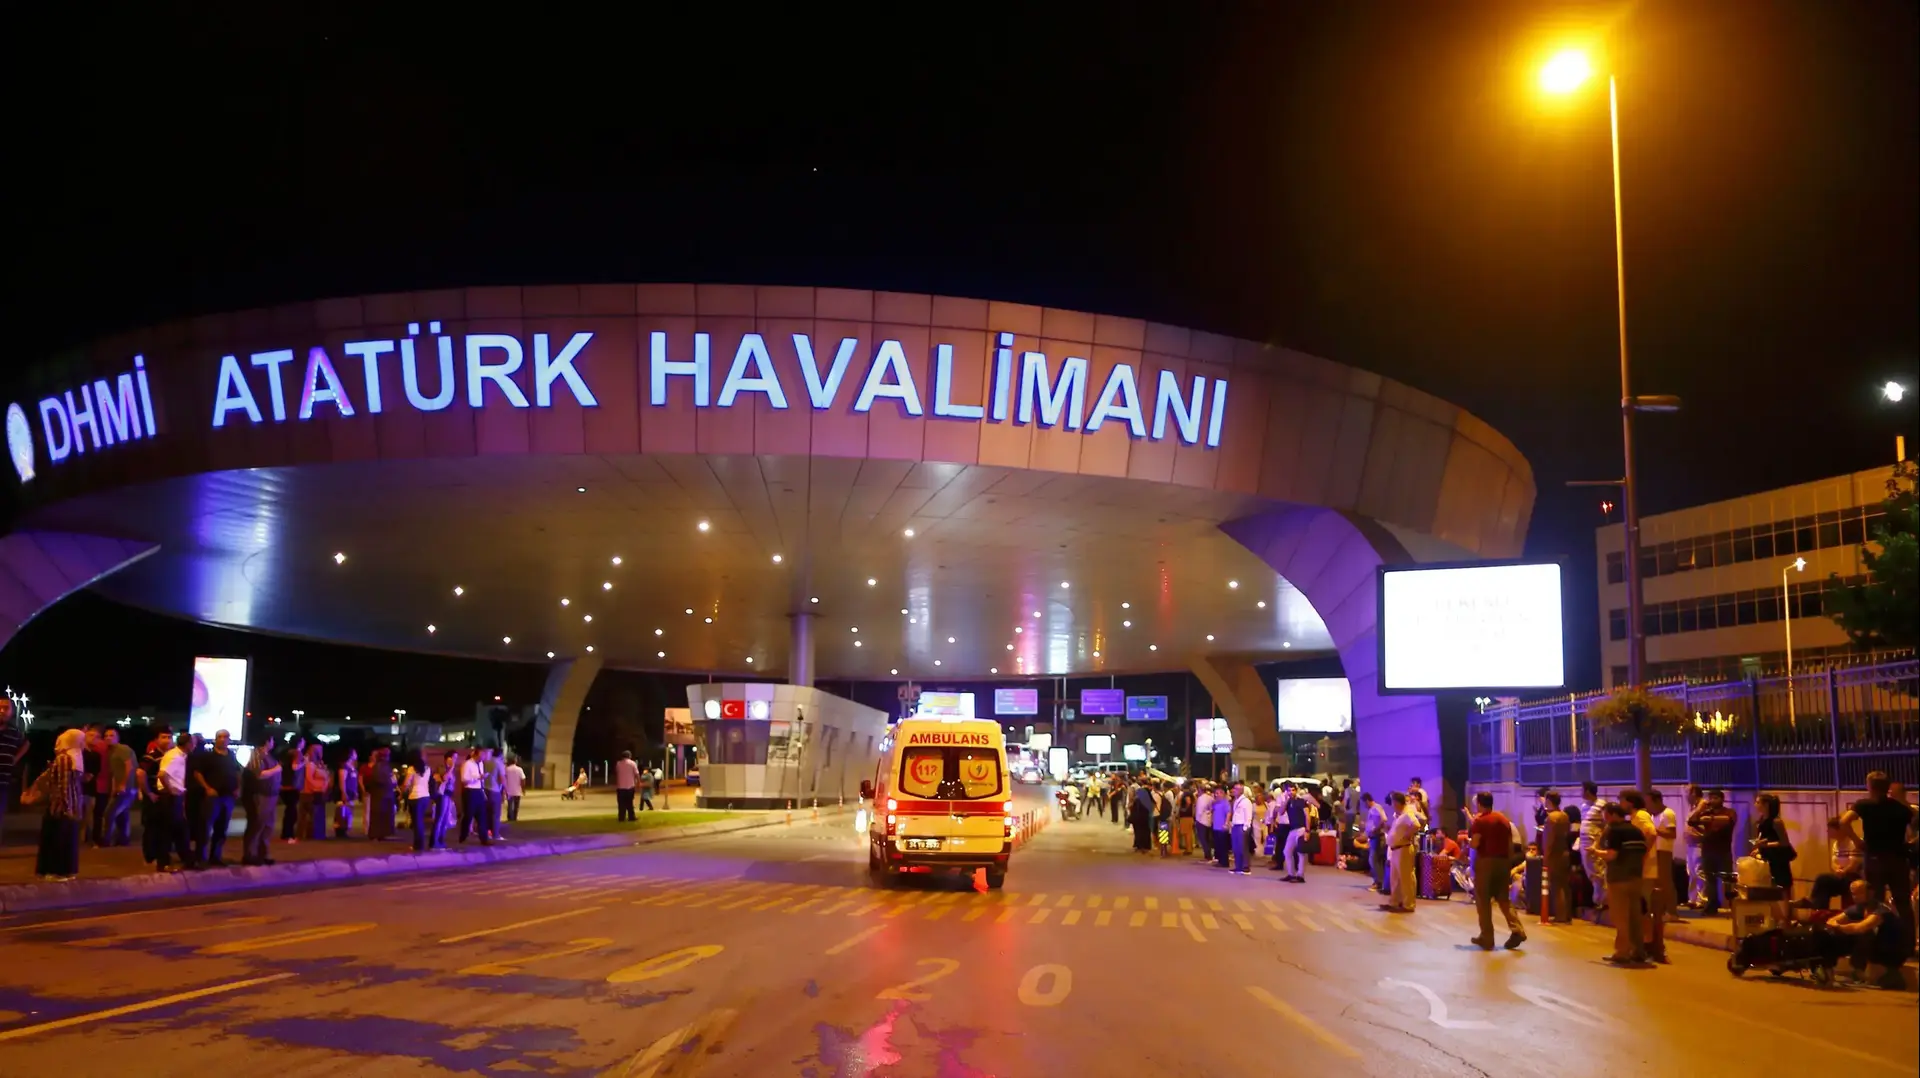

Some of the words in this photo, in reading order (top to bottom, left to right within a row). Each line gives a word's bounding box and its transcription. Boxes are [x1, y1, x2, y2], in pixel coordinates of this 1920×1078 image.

[38, 354, 157, 463] DHMİ
[212, 320, 598, 428] ATATÜRK
[650, 331, 1228, 447] HAVALİMANI
[909, 733, 990, 745] AMBULANS
[917, 765, 938, 777] 112
[874, 957, 1073, 1007] 20
